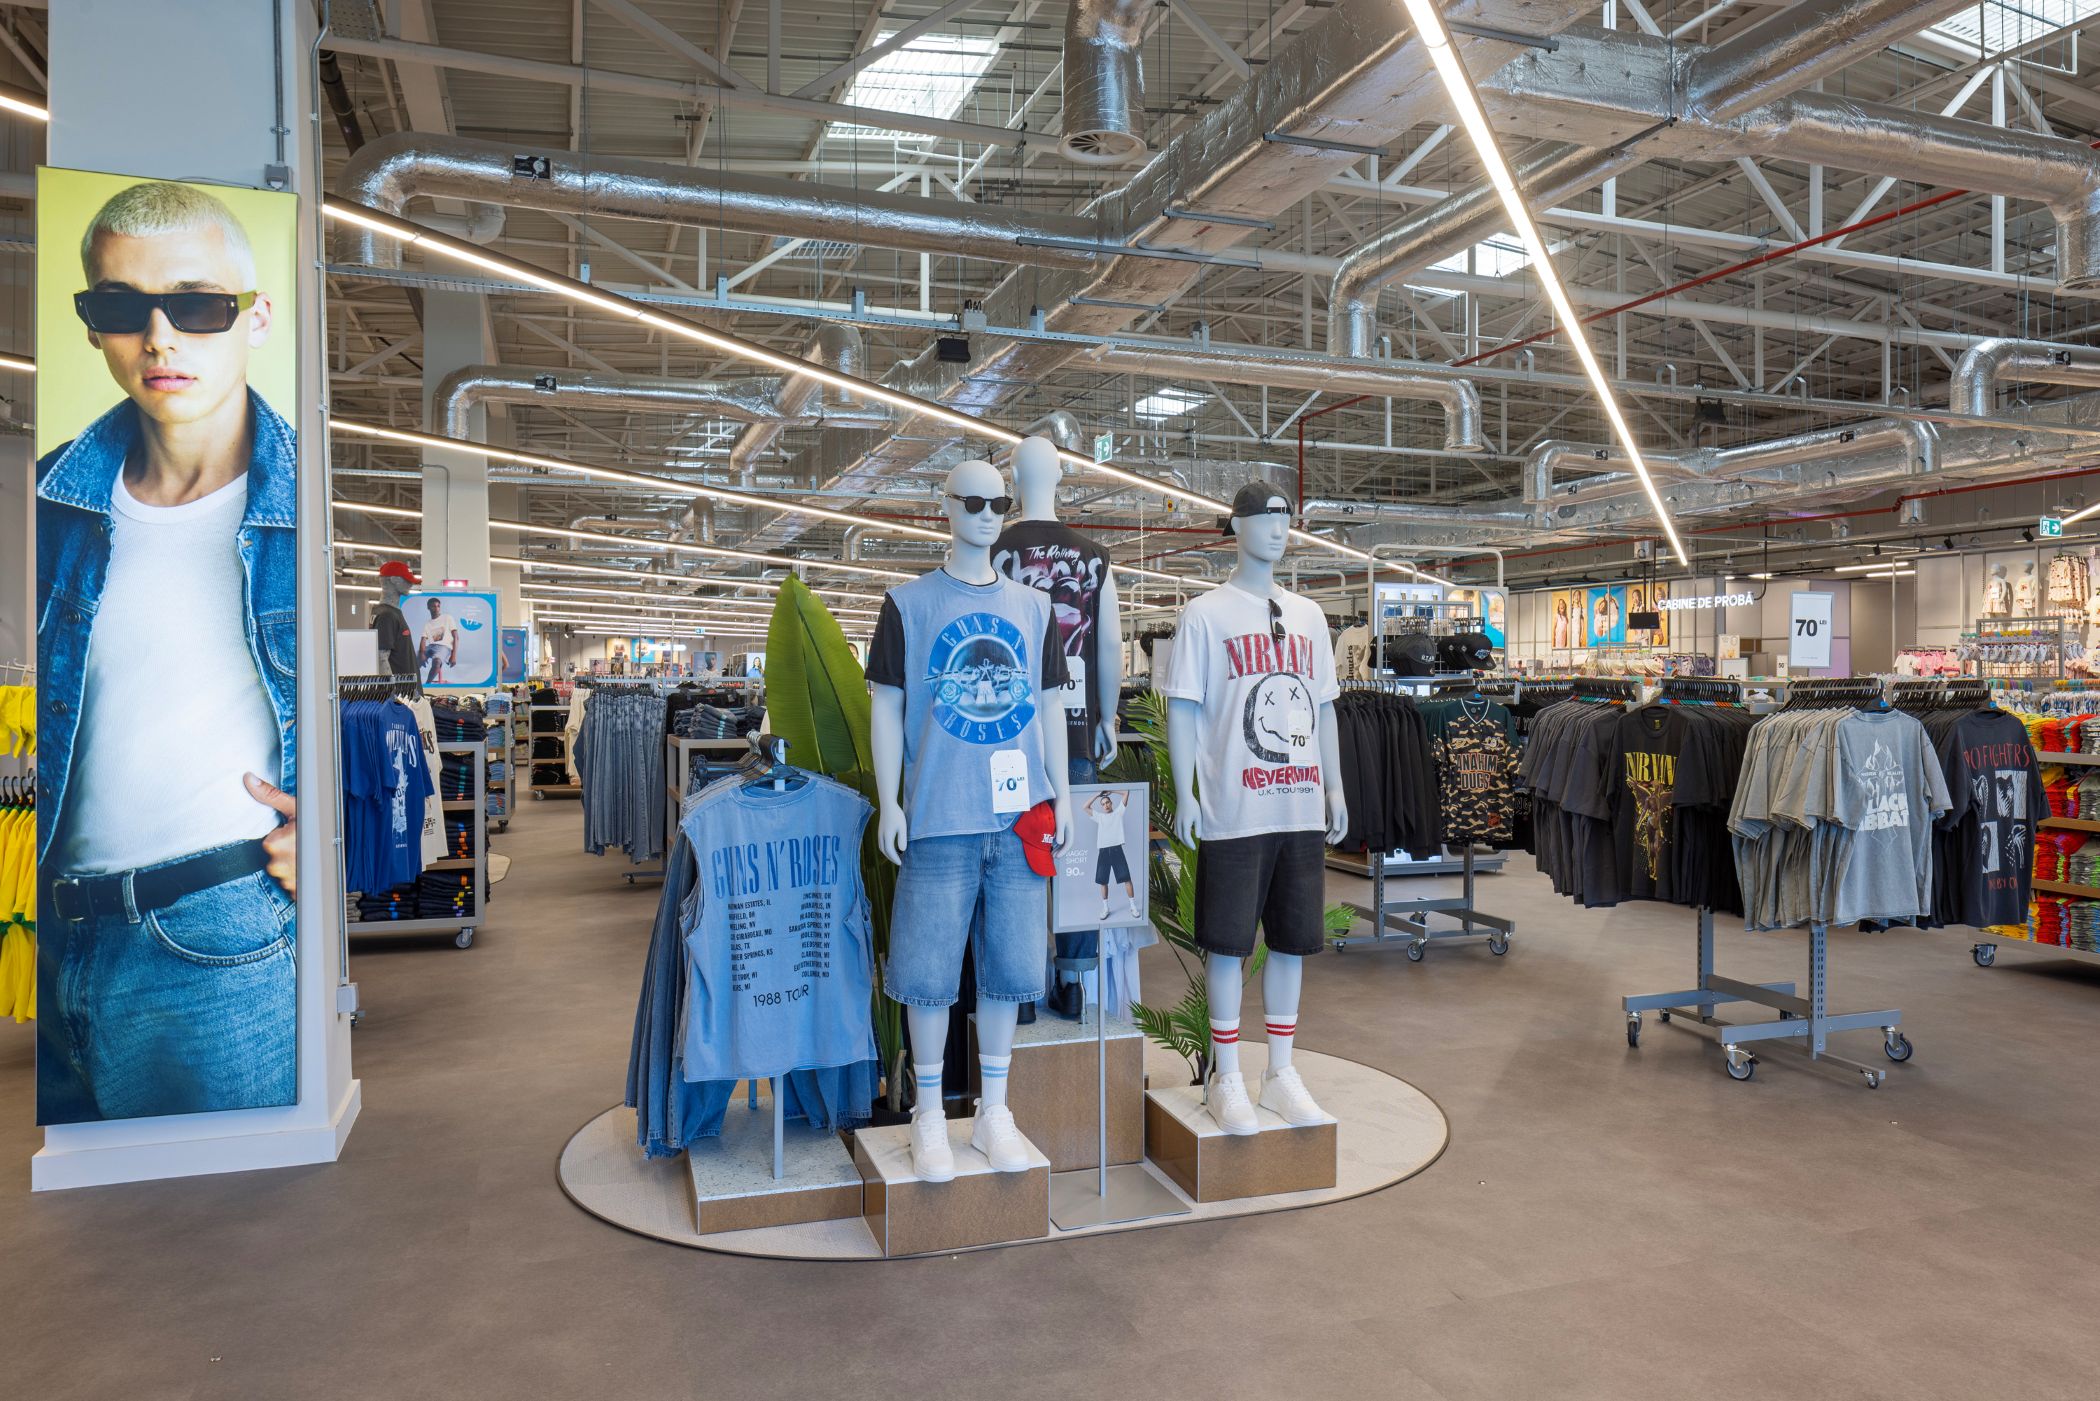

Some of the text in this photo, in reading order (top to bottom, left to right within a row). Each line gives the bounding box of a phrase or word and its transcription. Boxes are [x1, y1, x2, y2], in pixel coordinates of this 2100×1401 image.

[1025, 544, 1080, 565] The Rolling
[1657, 592, 1753, 611] CABINE DE PROBĂ
[942, 615, 1000, 647] GUNS
[1795, 619, 1817, 636] 70
[1223, 633, 1314, 680] NIRVANA
[943, 713, 1022, 741] ROSES
[1291, 734, 1305, 747] 70
[711, 843, 760, 899] GUNS
[788, 834, 841, 889] ROSES
[1066, 867, 1079, 876] 90
[753, 992, 781, 1007] 1988
